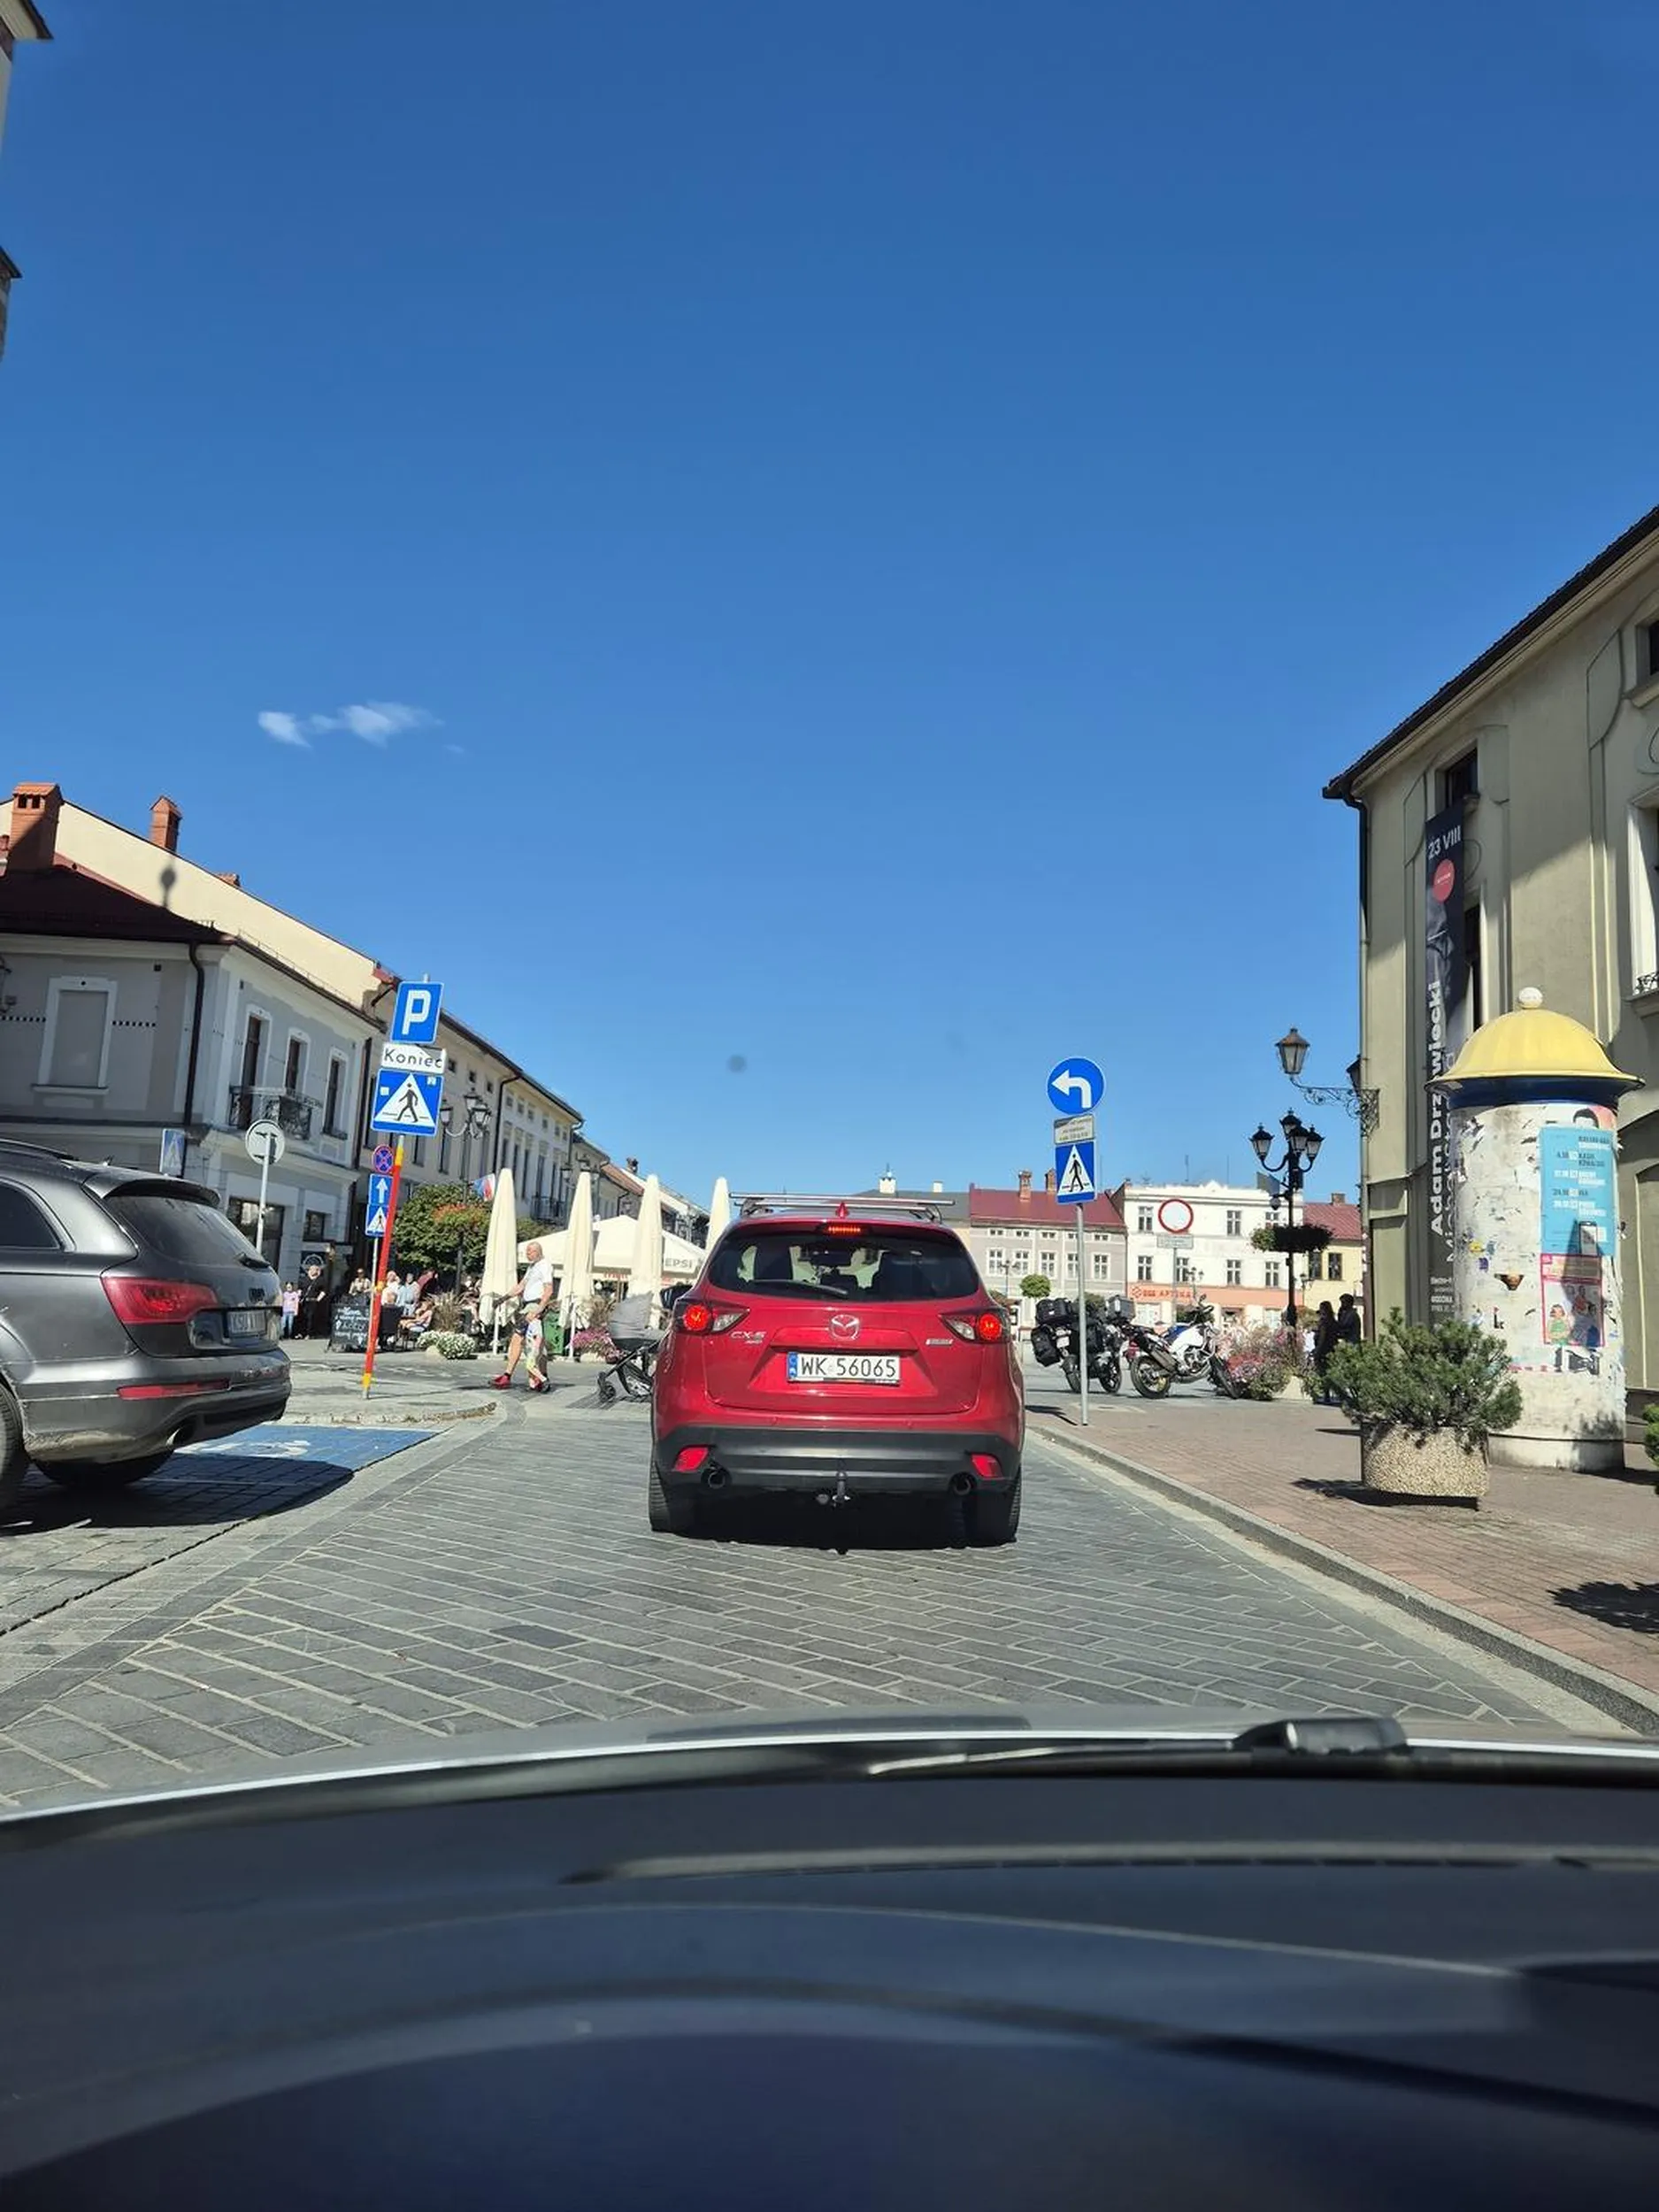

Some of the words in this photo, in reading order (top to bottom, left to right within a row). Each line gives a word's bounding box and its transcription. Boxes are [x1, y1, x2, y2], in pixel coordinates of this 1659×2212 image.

[1428, 838, 1440, 860] 23
[1443, 825, 1461, 849] VIII
[402, 990, 431, 1034] P
[384, 1048, 442, 1068] Koniec
[1428, 981, 1443, 1140] Drzwiecki
[1430, 1145, 1443, 1235] Adam
[664, 1258, 693, 1268] EPSI
[731, 1331, 767, 1340] CX-5
[802, 1356, 827, 1375] WK
[836, 1357, 895, 1378] 56065
